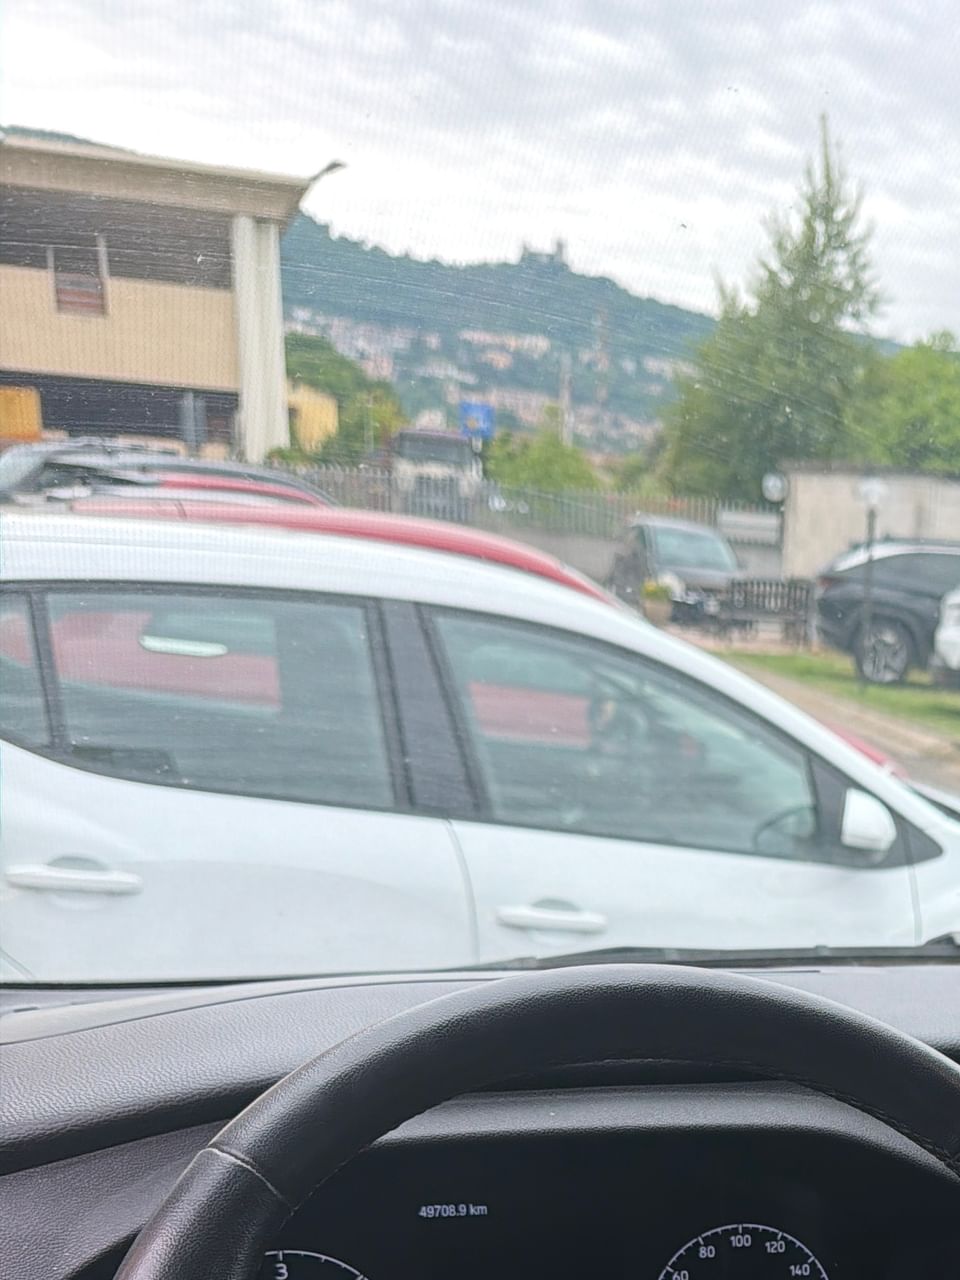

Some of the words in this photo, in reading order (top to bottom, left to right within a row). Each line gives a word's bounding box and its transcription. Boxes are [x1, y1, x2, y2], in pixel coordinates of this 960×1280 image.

[418, 1203, 467, 1218] 49708.9
[468, 1203, 488, 1216] km
[730, 1234, 752, 1247] 100
[765, 1240, 786, 1253] 120
[699, 1245, 716, 1259] 80
[275, 1263, 288, 1280] 3
[789, 1263, 810, 1277] 140
